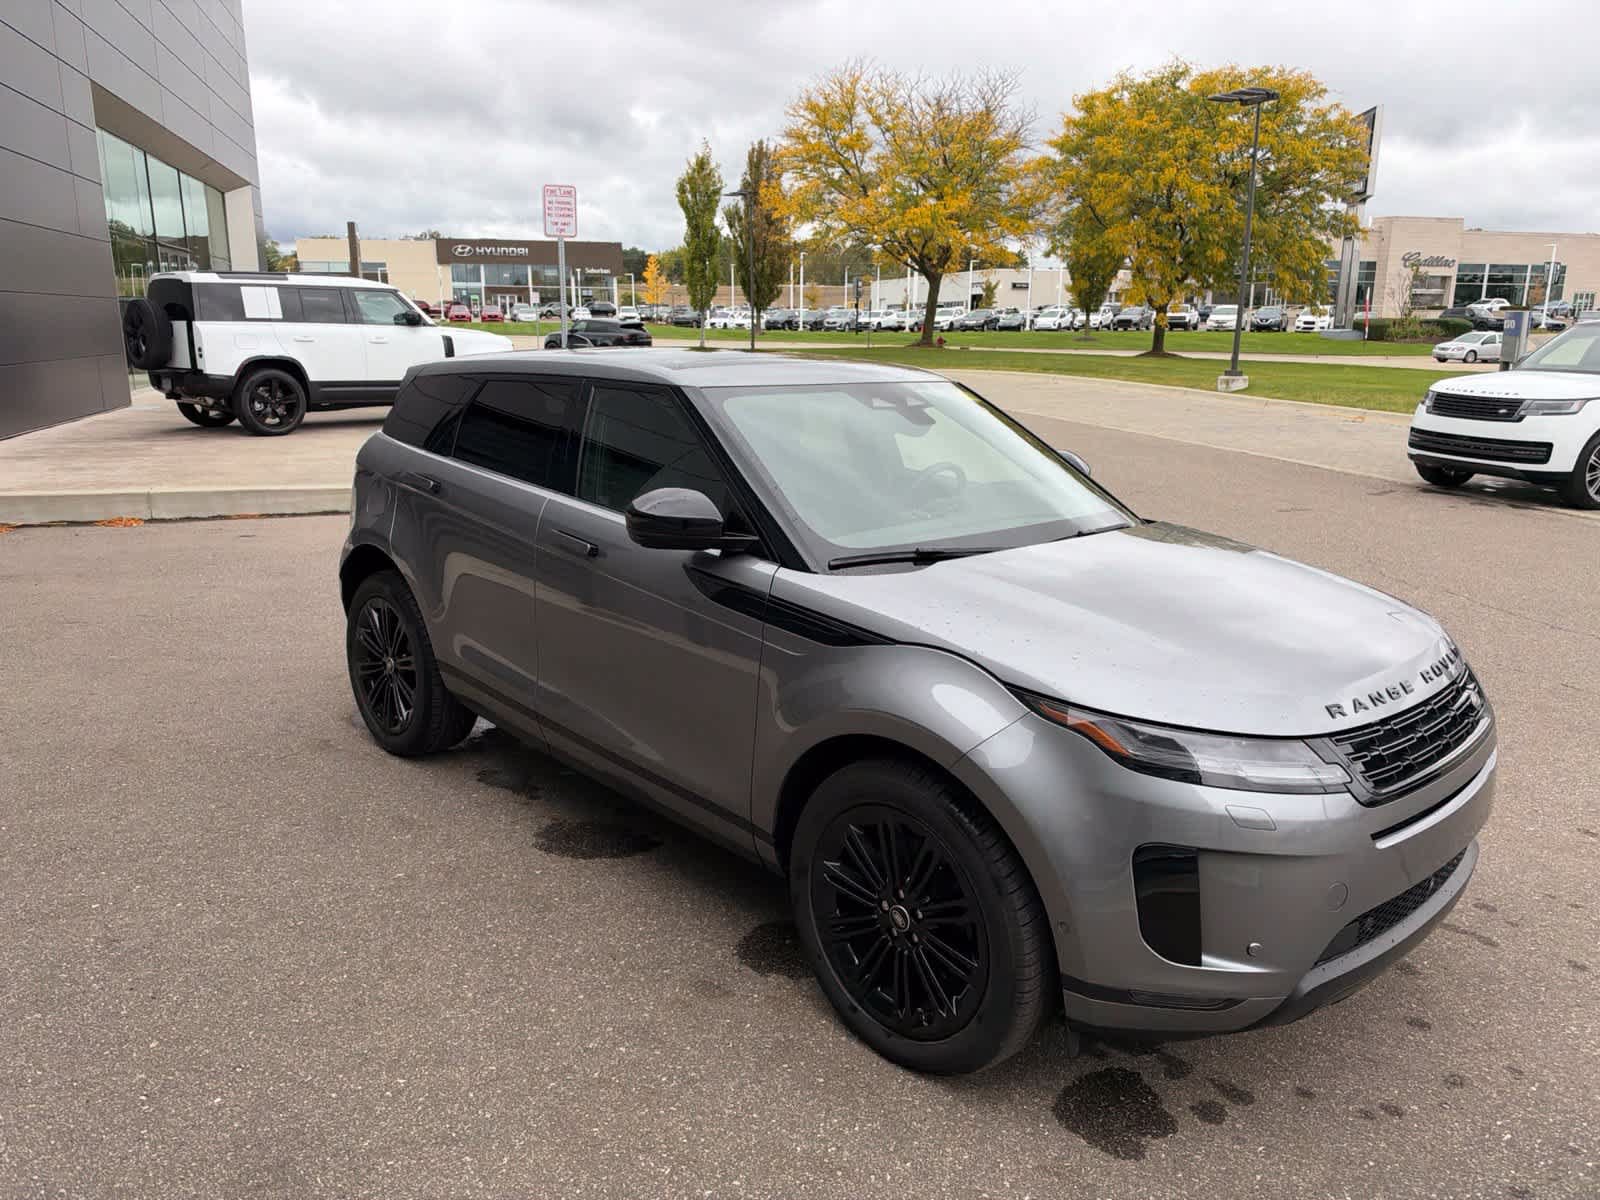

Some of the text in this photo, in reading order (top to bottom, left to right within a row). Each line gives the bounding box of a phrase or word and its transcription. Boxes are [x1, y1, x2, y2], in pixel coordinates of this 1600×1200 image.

[475, 246, 529, 257] HYUNDAI
[1401, 251, 1456, 268] Cadillac
[1325, 681, 1415, 719] RANGE
